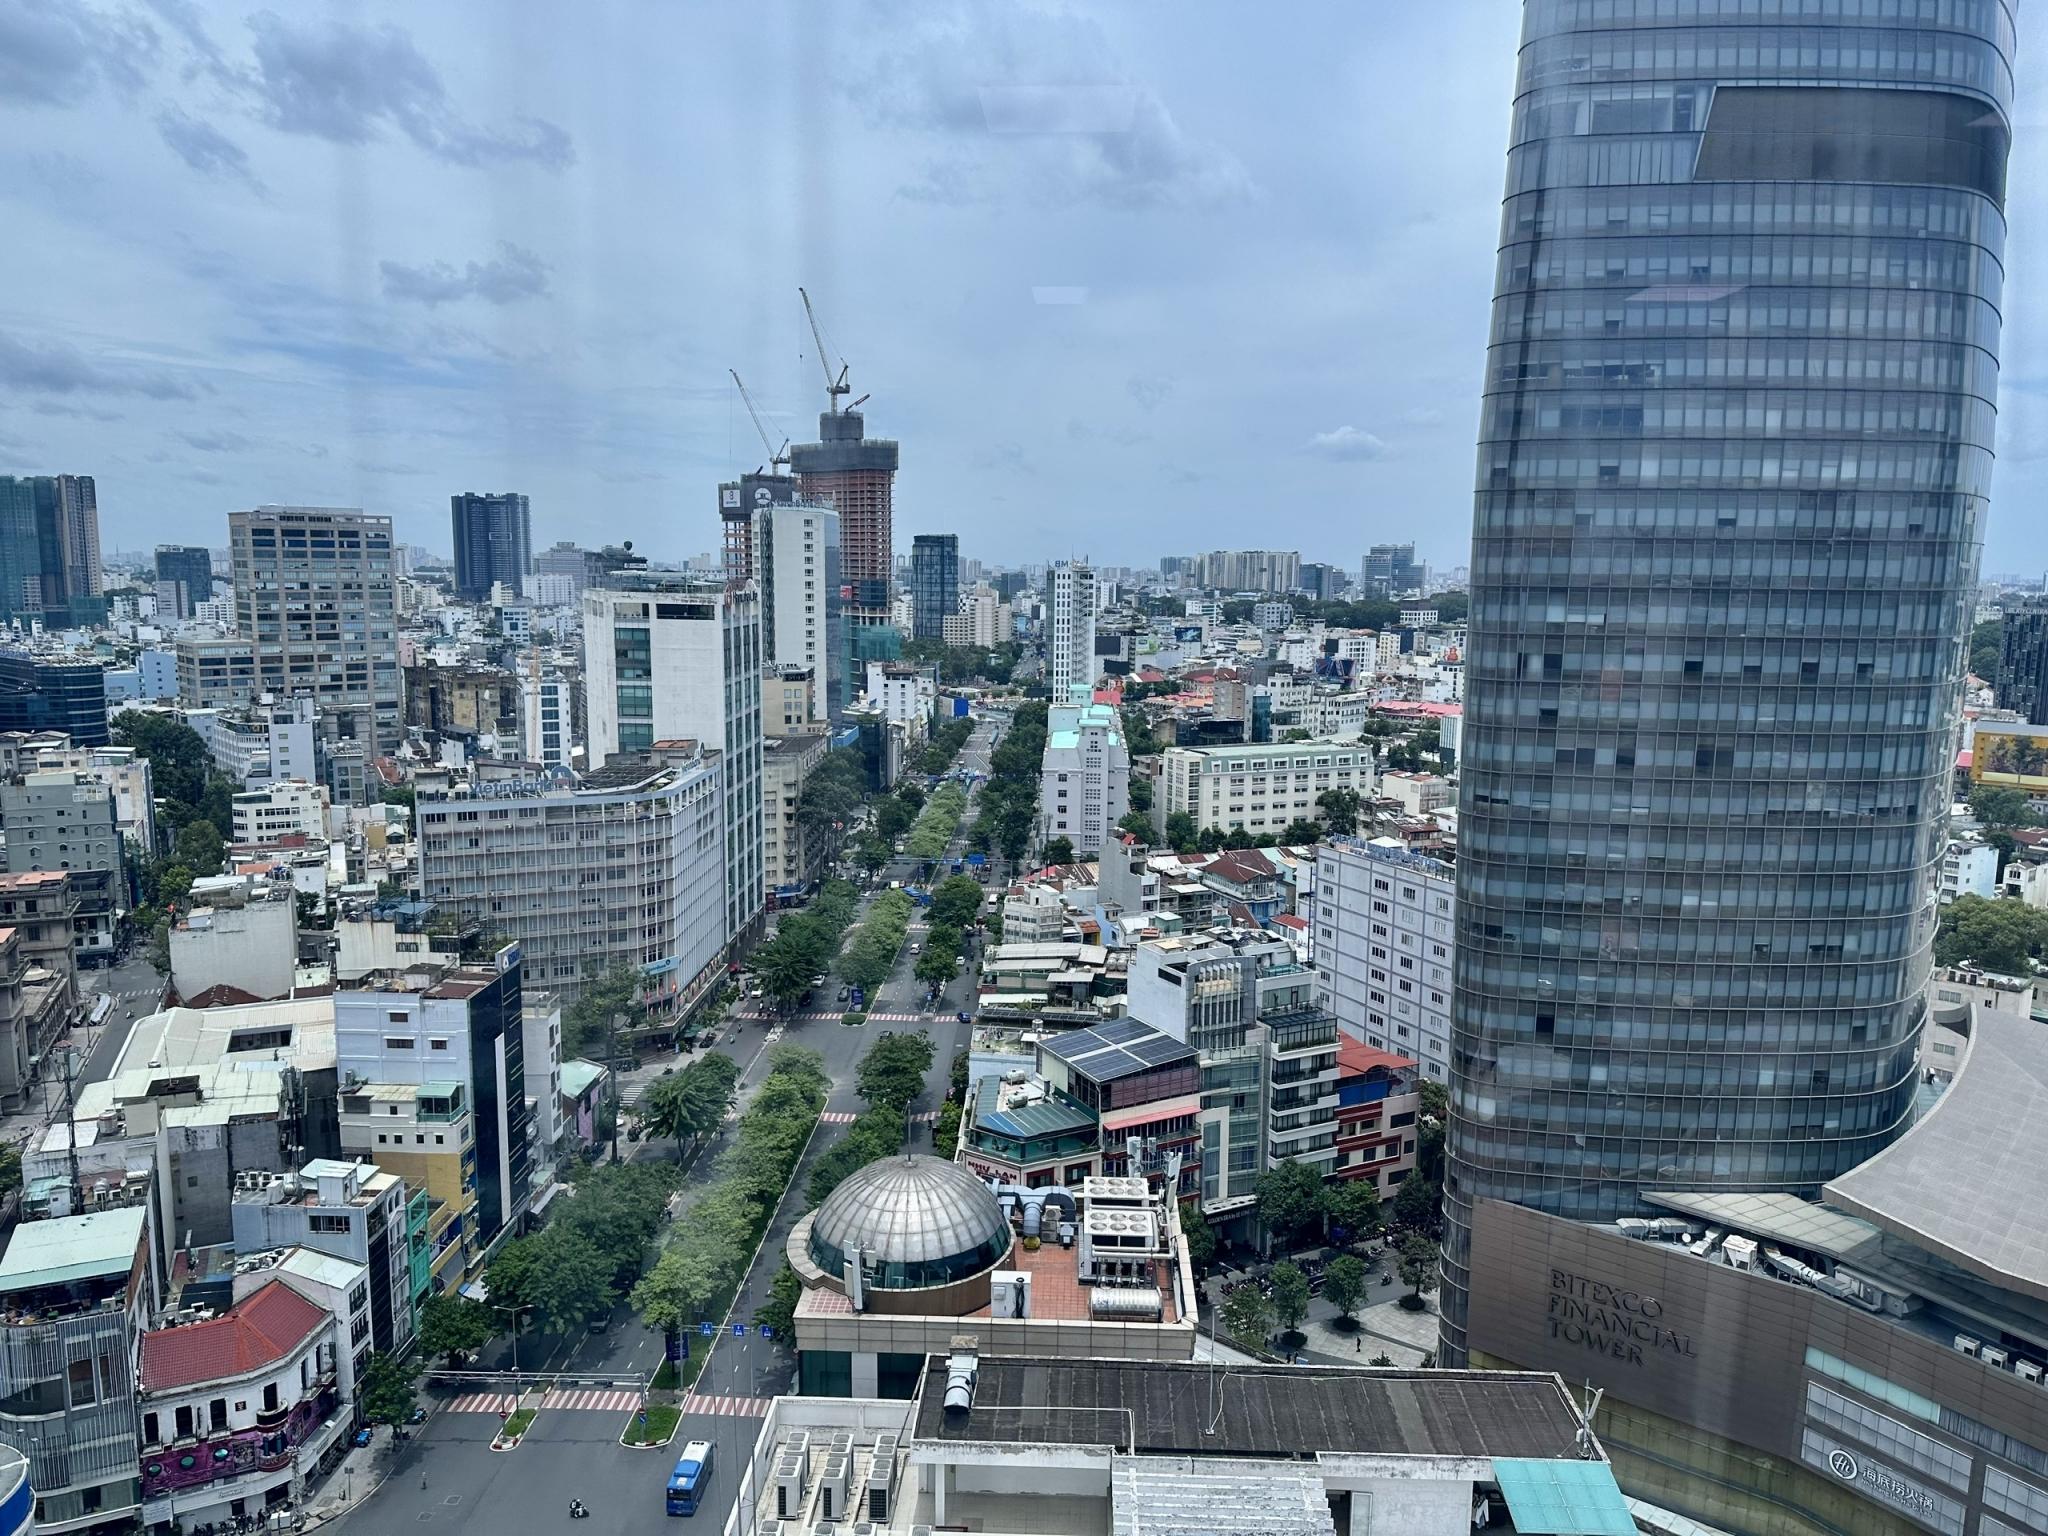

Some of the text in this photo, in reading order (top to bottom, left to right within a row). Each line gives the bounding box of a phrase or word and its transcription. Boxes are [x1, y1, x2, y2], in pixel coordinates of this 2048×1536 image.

[471, 779, 551, 794] VietinBank
[1551, 1268, 1663, 1318] BITEXCO
[1548, 1317, 1644, 1368] TOWER
[1549, 1292, 1698, 1359] FINANCIAL
[1834, 1456, 1850, 1473] Hi
[1863, 1467, 1934, 1511] 海底捞火锅
